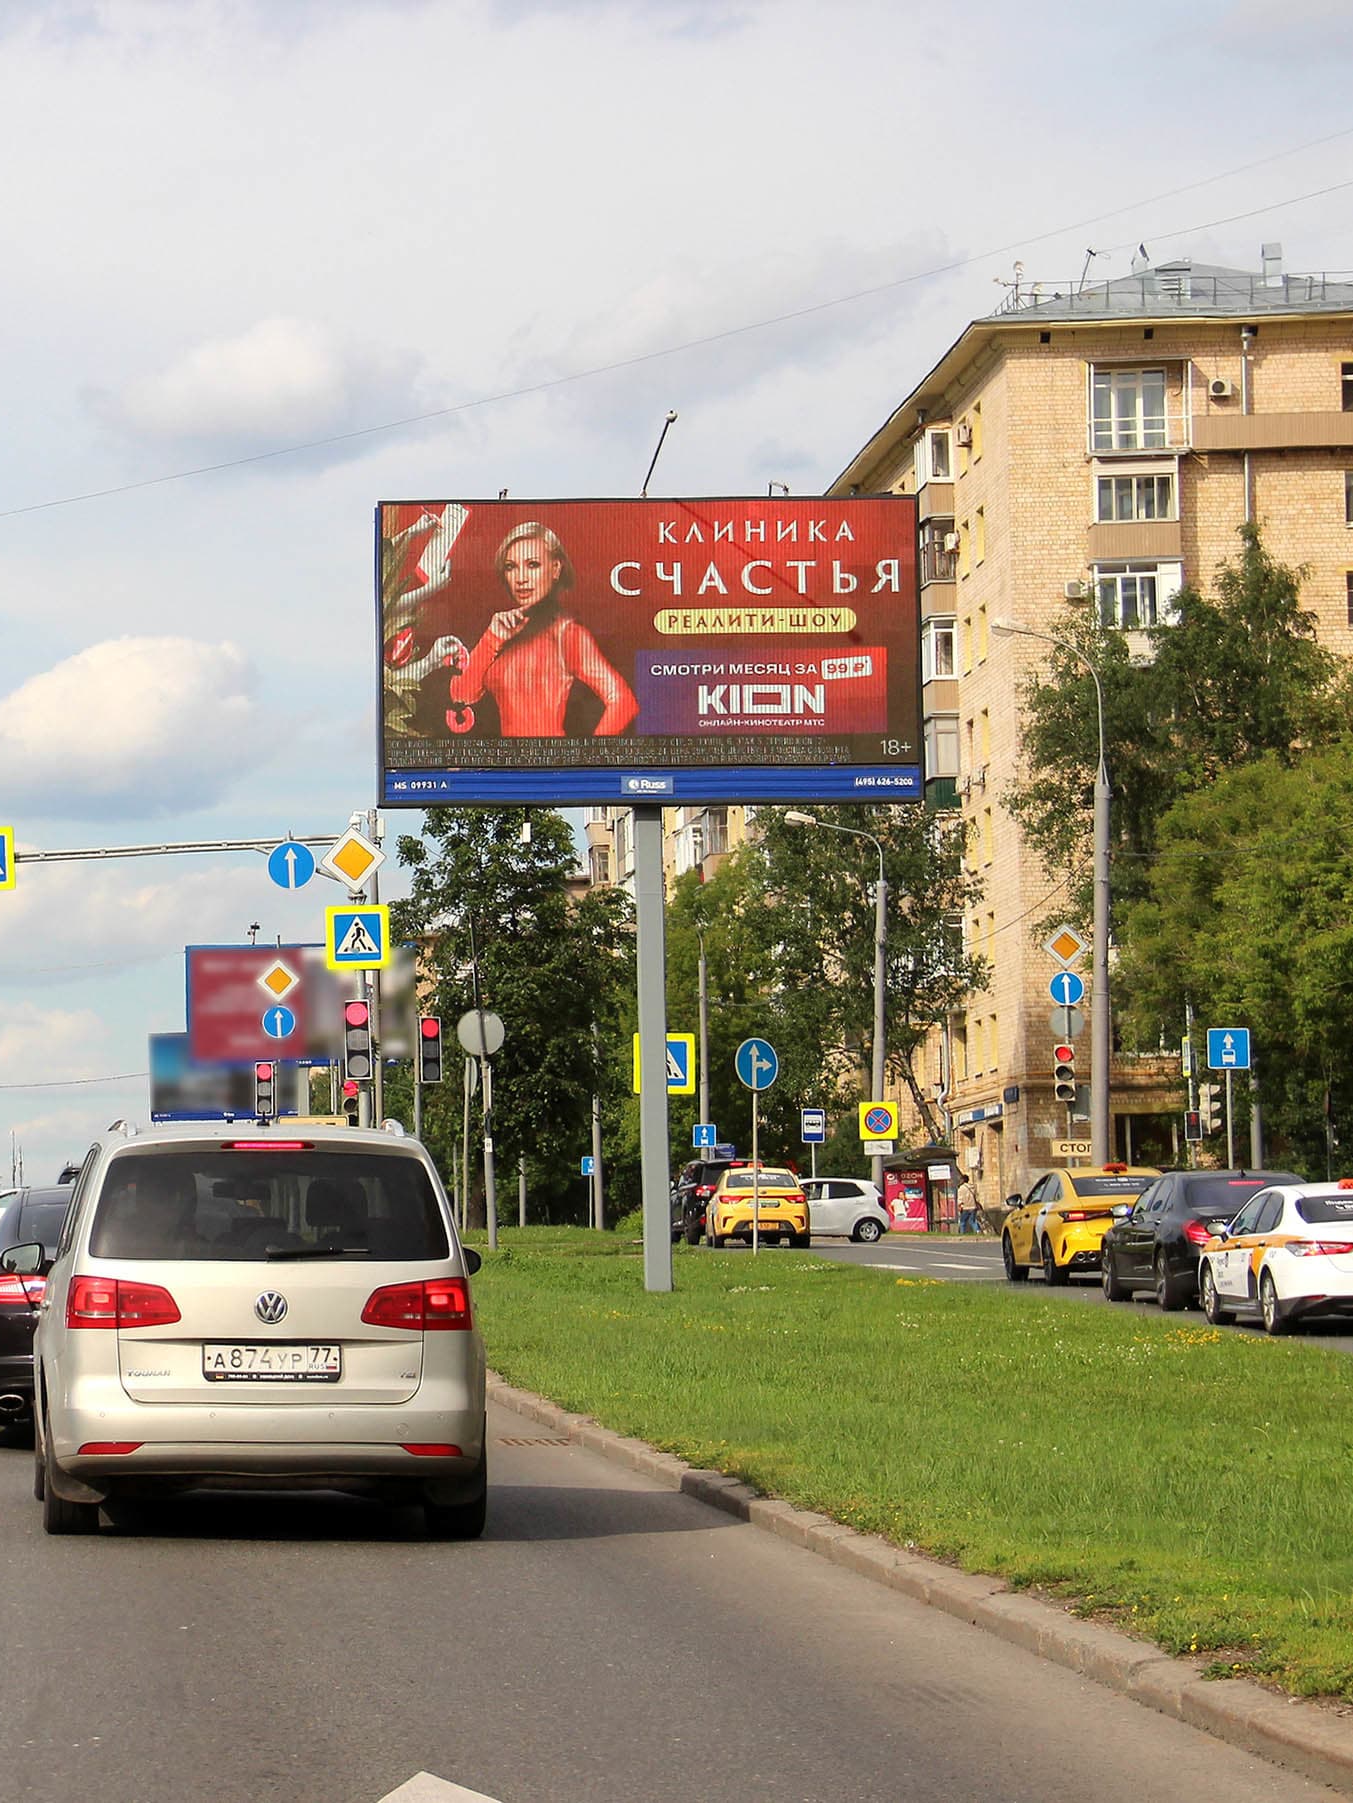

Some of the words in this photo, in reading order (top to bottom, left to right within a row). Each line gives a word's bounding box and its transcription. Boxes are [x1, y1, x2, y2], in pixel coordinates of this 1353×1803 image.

[658, 520, 855, 544] КЛИНИКА
[609, 559, 900, 596] СЧАСТЬЯ
[668, 612, 842, 629] РЕАЛИТИ-ШОУ
[650, 663, 725, 676] СМОТРИ
[728, 662, 790, 676] МЕСЯЦ
[794, 662, 818, 675] ЗА
[827, 663, 847, 673] 99
[698, 684, 825, 715] KION
[698, 718, 803, 728] ОНЛАЙН-КИНОТЕАТР
[804, 719, 825, 727] МТС
[880, 739, 912, 756] 18+
[640, 779, 666, 789] Russ
[309, 1347, 332, 1363] 77
